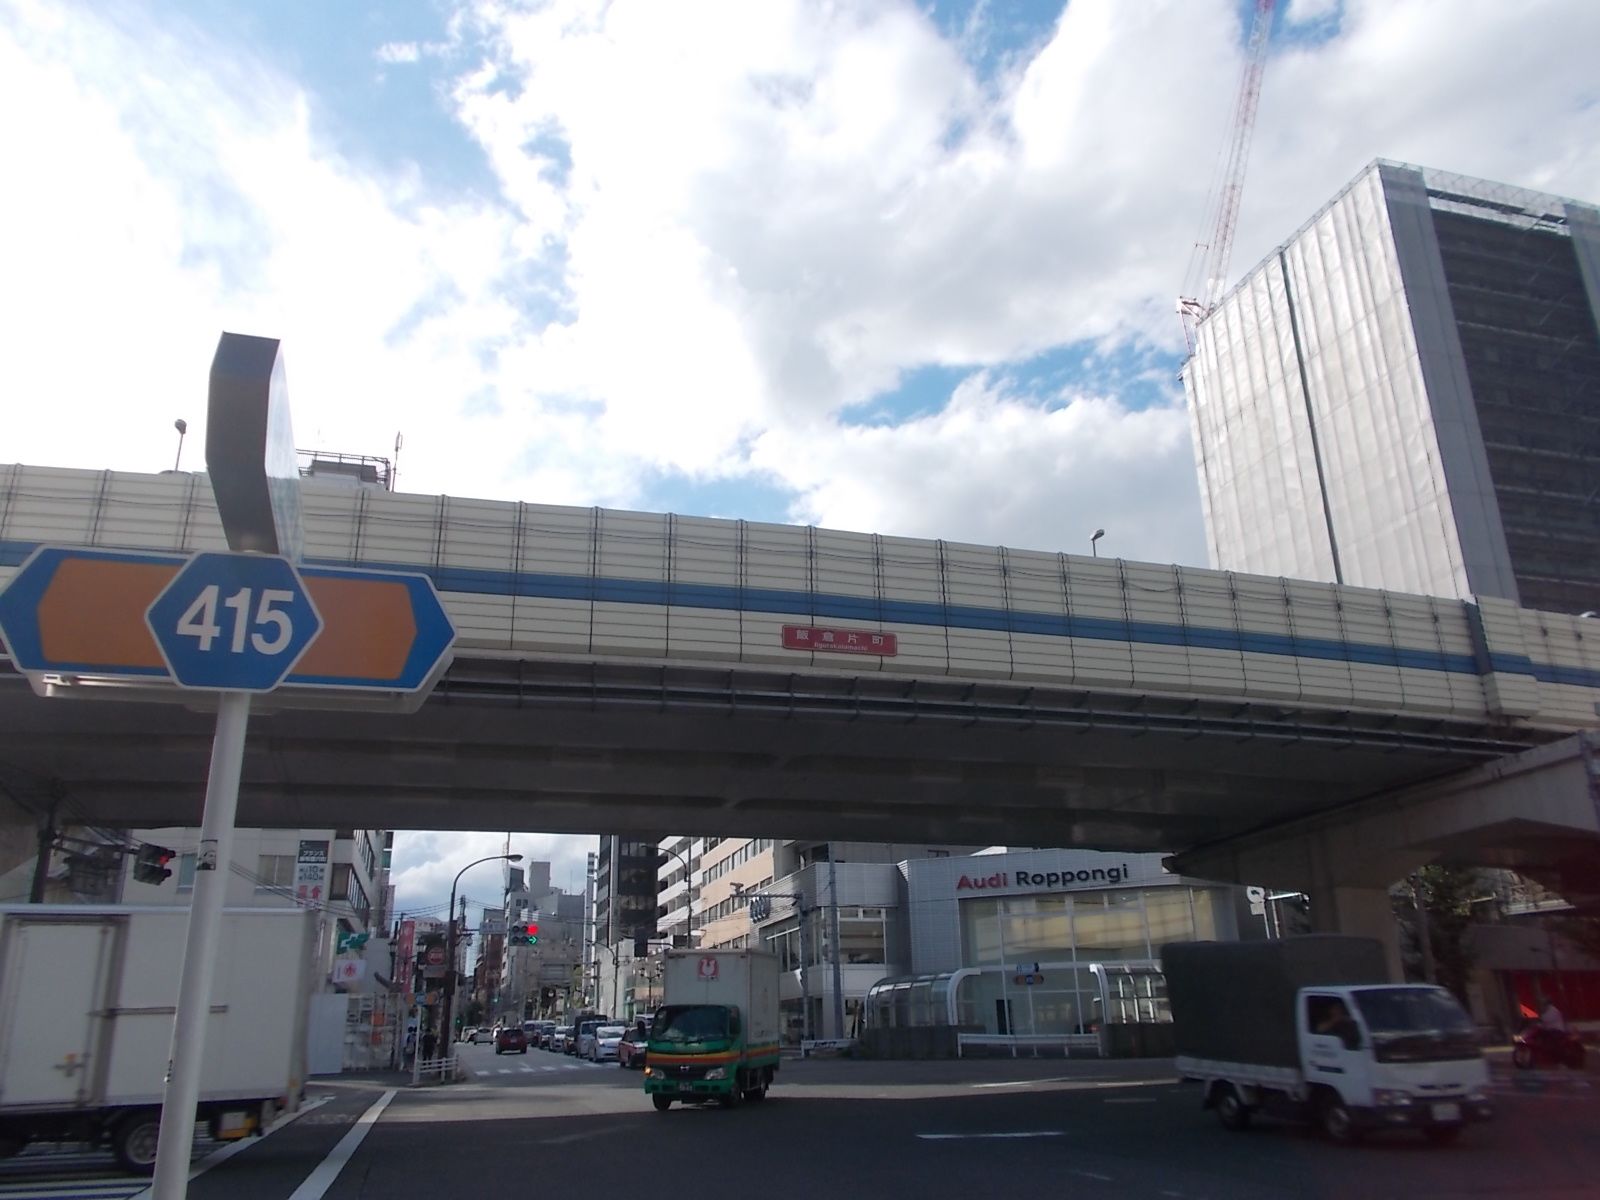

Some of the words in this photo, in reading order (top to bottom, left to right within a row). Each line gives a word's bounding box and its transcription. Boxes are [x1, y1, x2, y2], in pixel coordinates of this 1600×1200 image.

[176, 585, 294, 655] 415
[957, 872, 1008, 890] Audi
[1016, 863, 1129, 887] Roppongi
